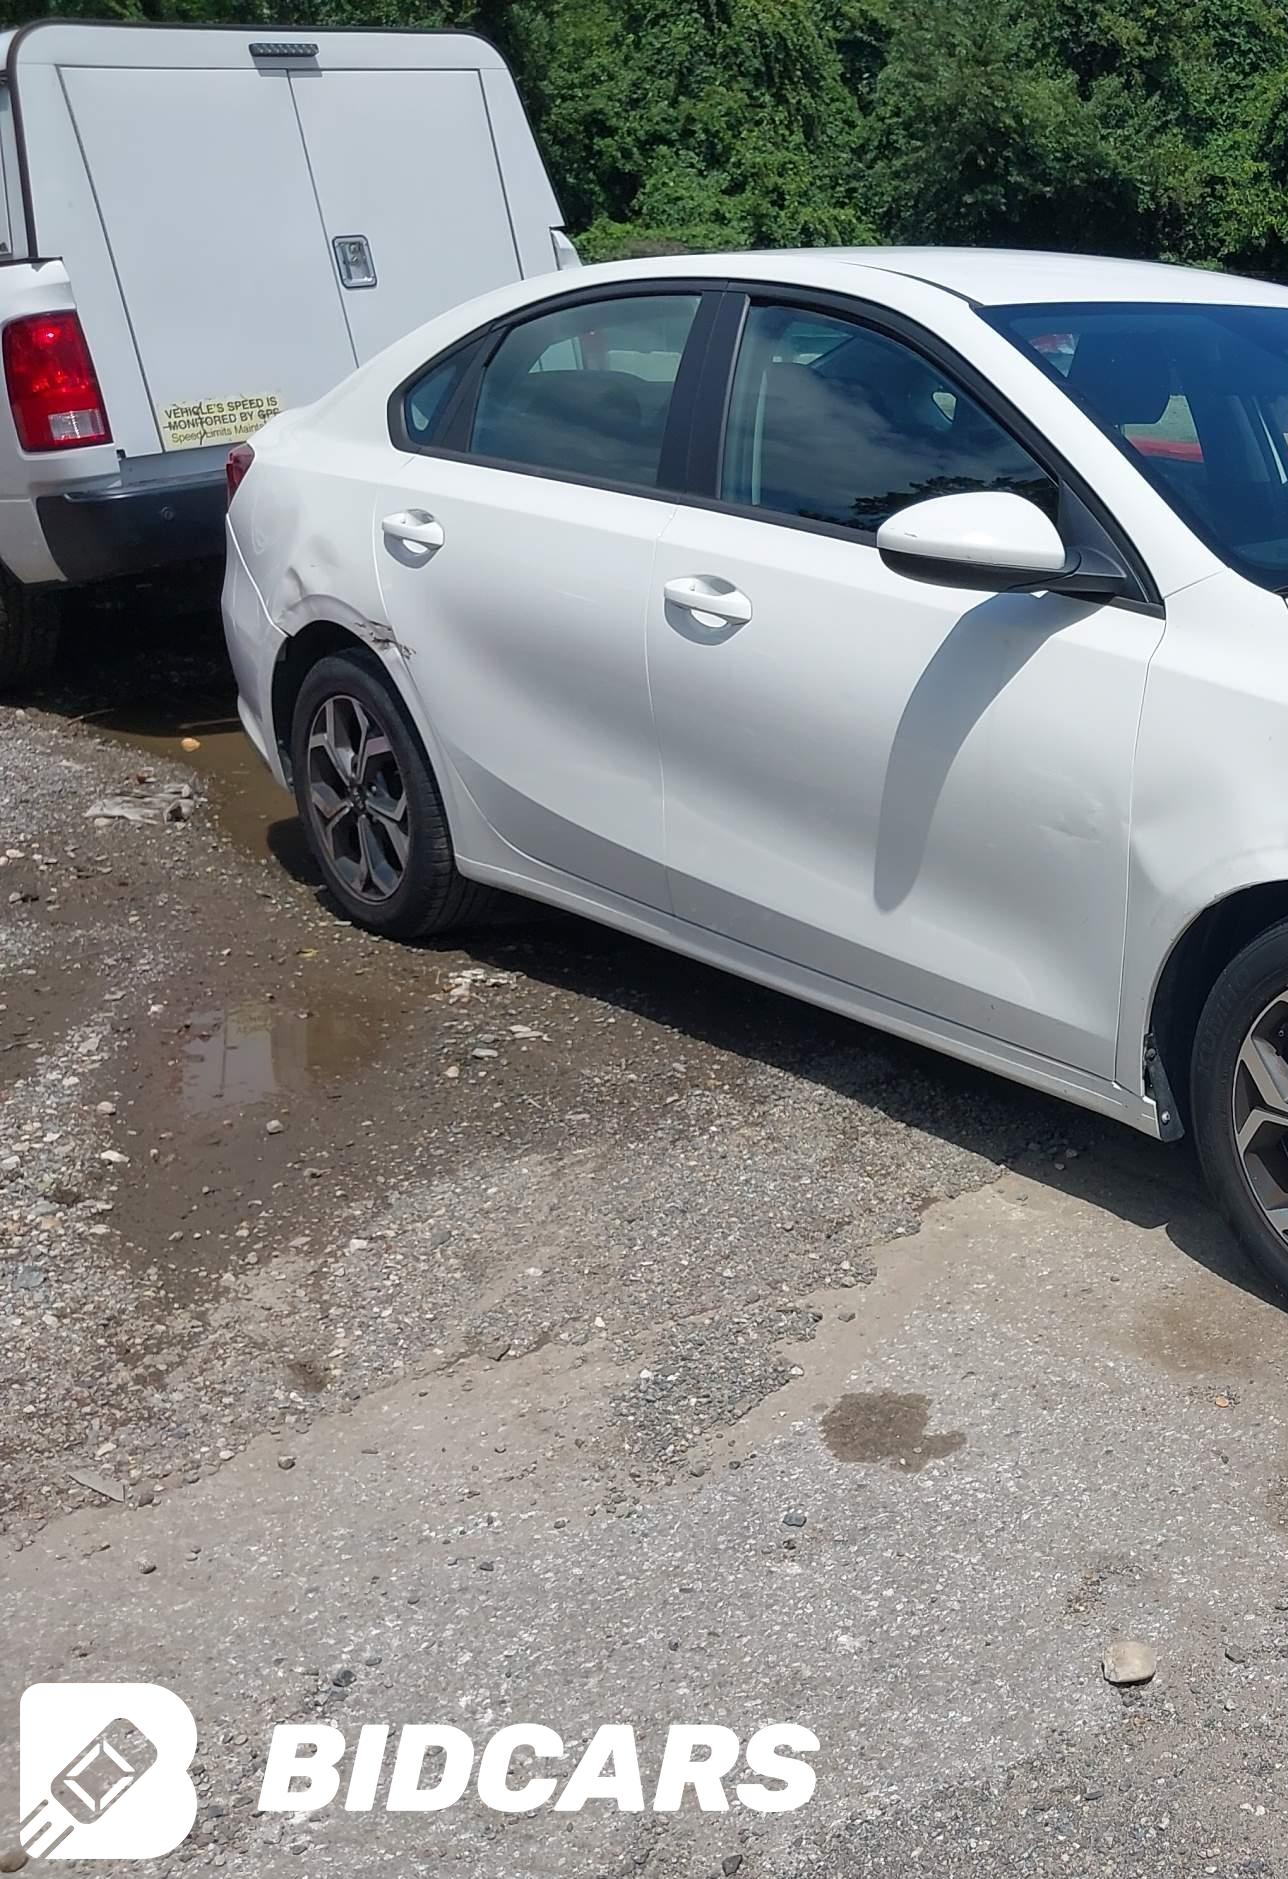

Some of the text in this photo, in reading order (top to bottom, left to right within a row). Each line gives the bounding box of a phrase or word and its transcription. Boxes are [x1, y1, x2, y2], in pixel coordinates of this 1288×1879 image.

[164, 396, 278, 419] VEHICLE'S SPEED IS
[167, 413, 237, 431] MONITORED
[240, 411, 254, 422] BY
[171, 430, 203, 444] Speed
